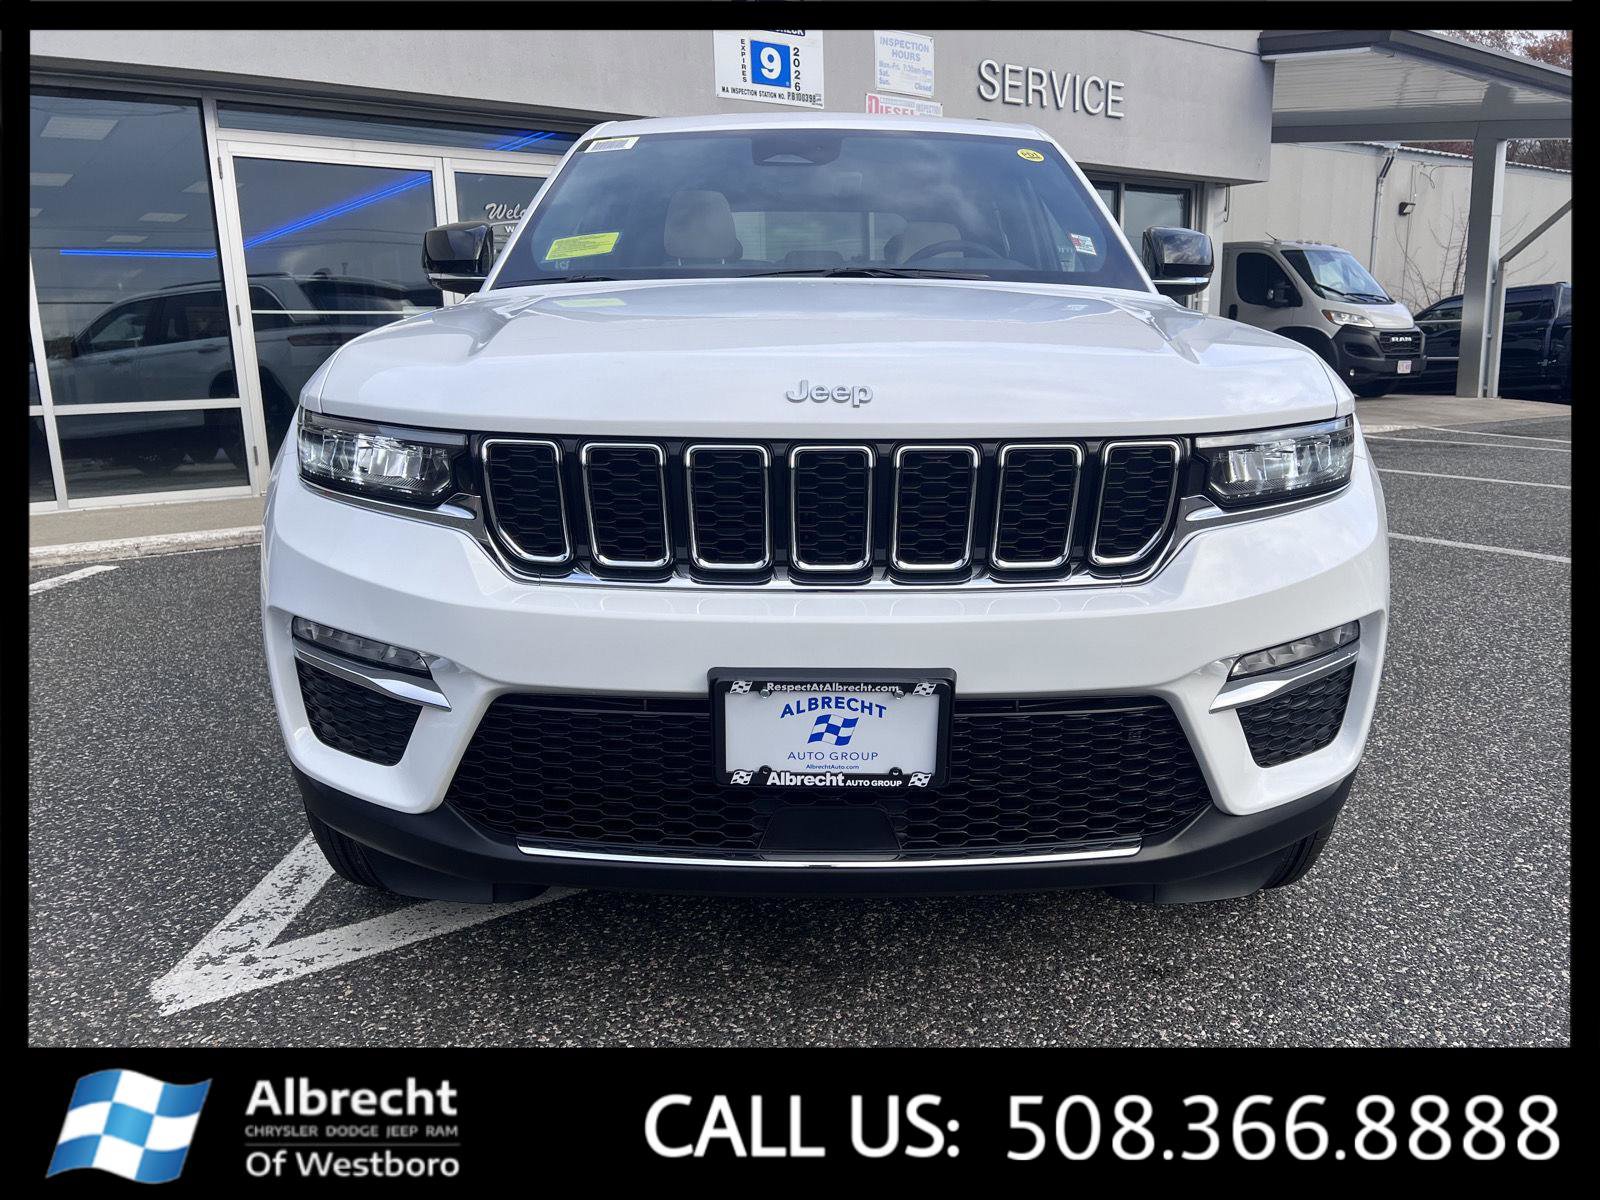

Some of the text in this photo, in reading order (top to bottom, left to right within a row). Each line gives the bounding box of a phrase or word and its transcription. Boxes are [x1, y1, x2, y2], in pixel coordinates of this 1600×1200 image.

[879, 36, 930, 53] INSPECTION
[740, 39, 748, 83] EXPIRES
[760, 46, 782, 80] 9
[891, 49, 921, 62] HOURS
[793, 47, 801, 91] 2026
[721, 86, 730, 94] MA
[731, 87, 758, 97] INSPECTION
[759, 90, 777, 98] STATION
[978, 59, 1125, 119] SERVICE
[785, 379, 874, 408] Jeep
[766, 682, 900, 693] RespectAtAlbrecht.com
[780, 696, 887, 719] ALBRECHT
[787, 751, 879, 761] AUTO GROUP
[766, 771, 902, 787] Albrecht AUTO GROUP
